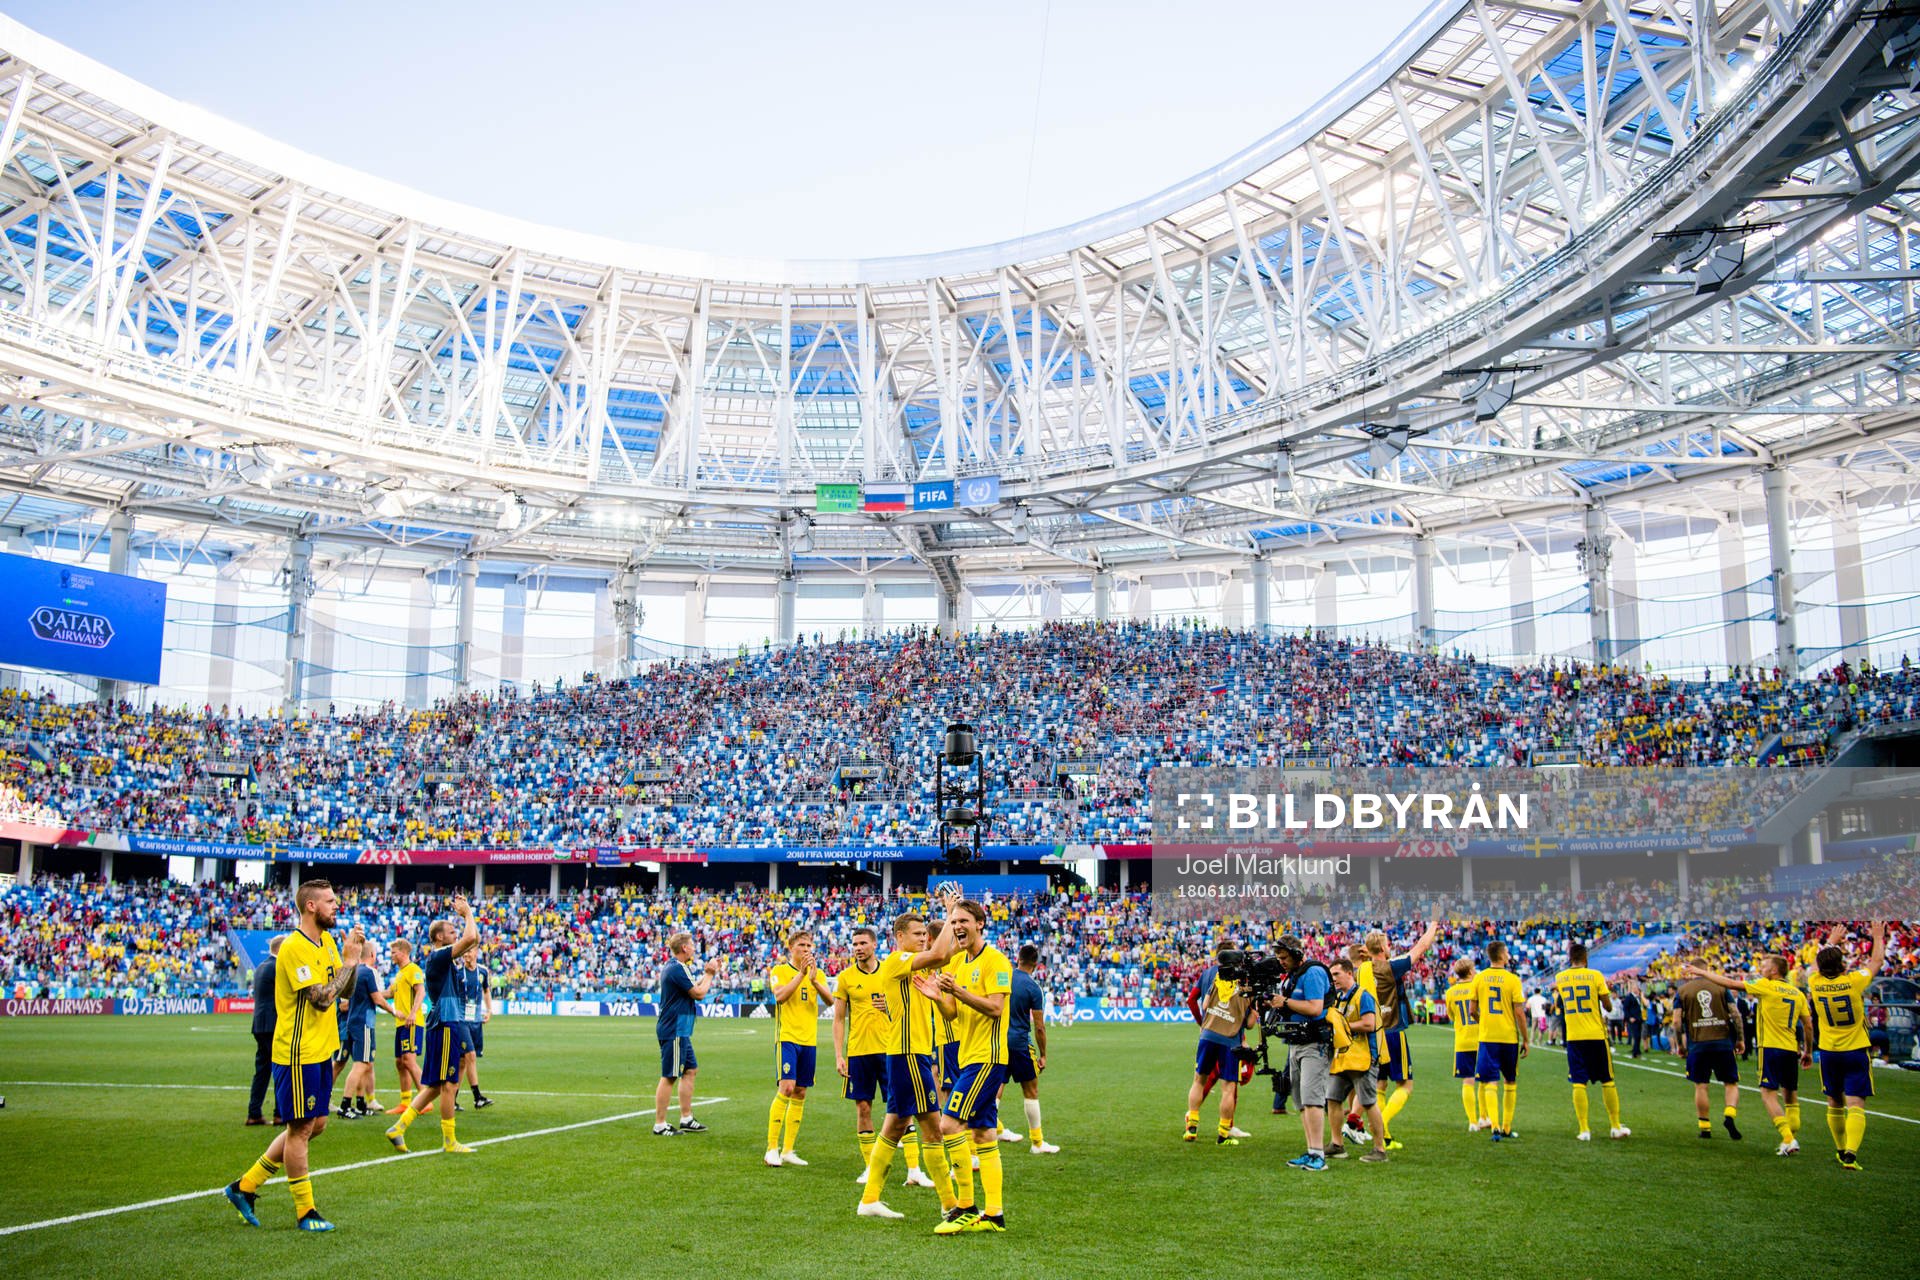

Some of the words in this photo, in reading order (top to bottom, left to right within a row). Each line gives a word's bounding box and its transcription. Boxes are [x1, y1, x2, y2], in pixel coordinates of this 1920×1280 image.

[919, 490, 948, 502] FIFA
[37, 609, 104, 635] QATAR
[53, 629, 105, 645] AIRWAYS
[1661, 837, 1680, 847] FIFA
[212, 847, 224, 855] ПО
[786, 851, 804, 859] 2018
[823, 851, 852, 859] WORLD
[854, 850, 871, 858] CUP
[874, 850, 904, 858] RUSSIA
[802, 988, 807, 1000] 6
[1489, 987, 1503, 1014] 2
[1562, 986, 1592, 1014] 22
[6, 1000, 49, 1016] QATAR
[52, 999, 103, 1015] AIRWAYS
[165, 999, 207, 1014] WANDA
[507, 1001, 552, 1015] GAZPROM
[606, 1003, 640, 1016] VISA
[699, 1004, 735, 1017] VISA
[1100, 1006, 1144, 1020] vivo
[1150, 1006, 1195, 1020] vivo
[1783, 998, 1795, 1028] 7
[1818, 995, 1855, 1027] 13
[948, 1091, 963, 1112] 8
